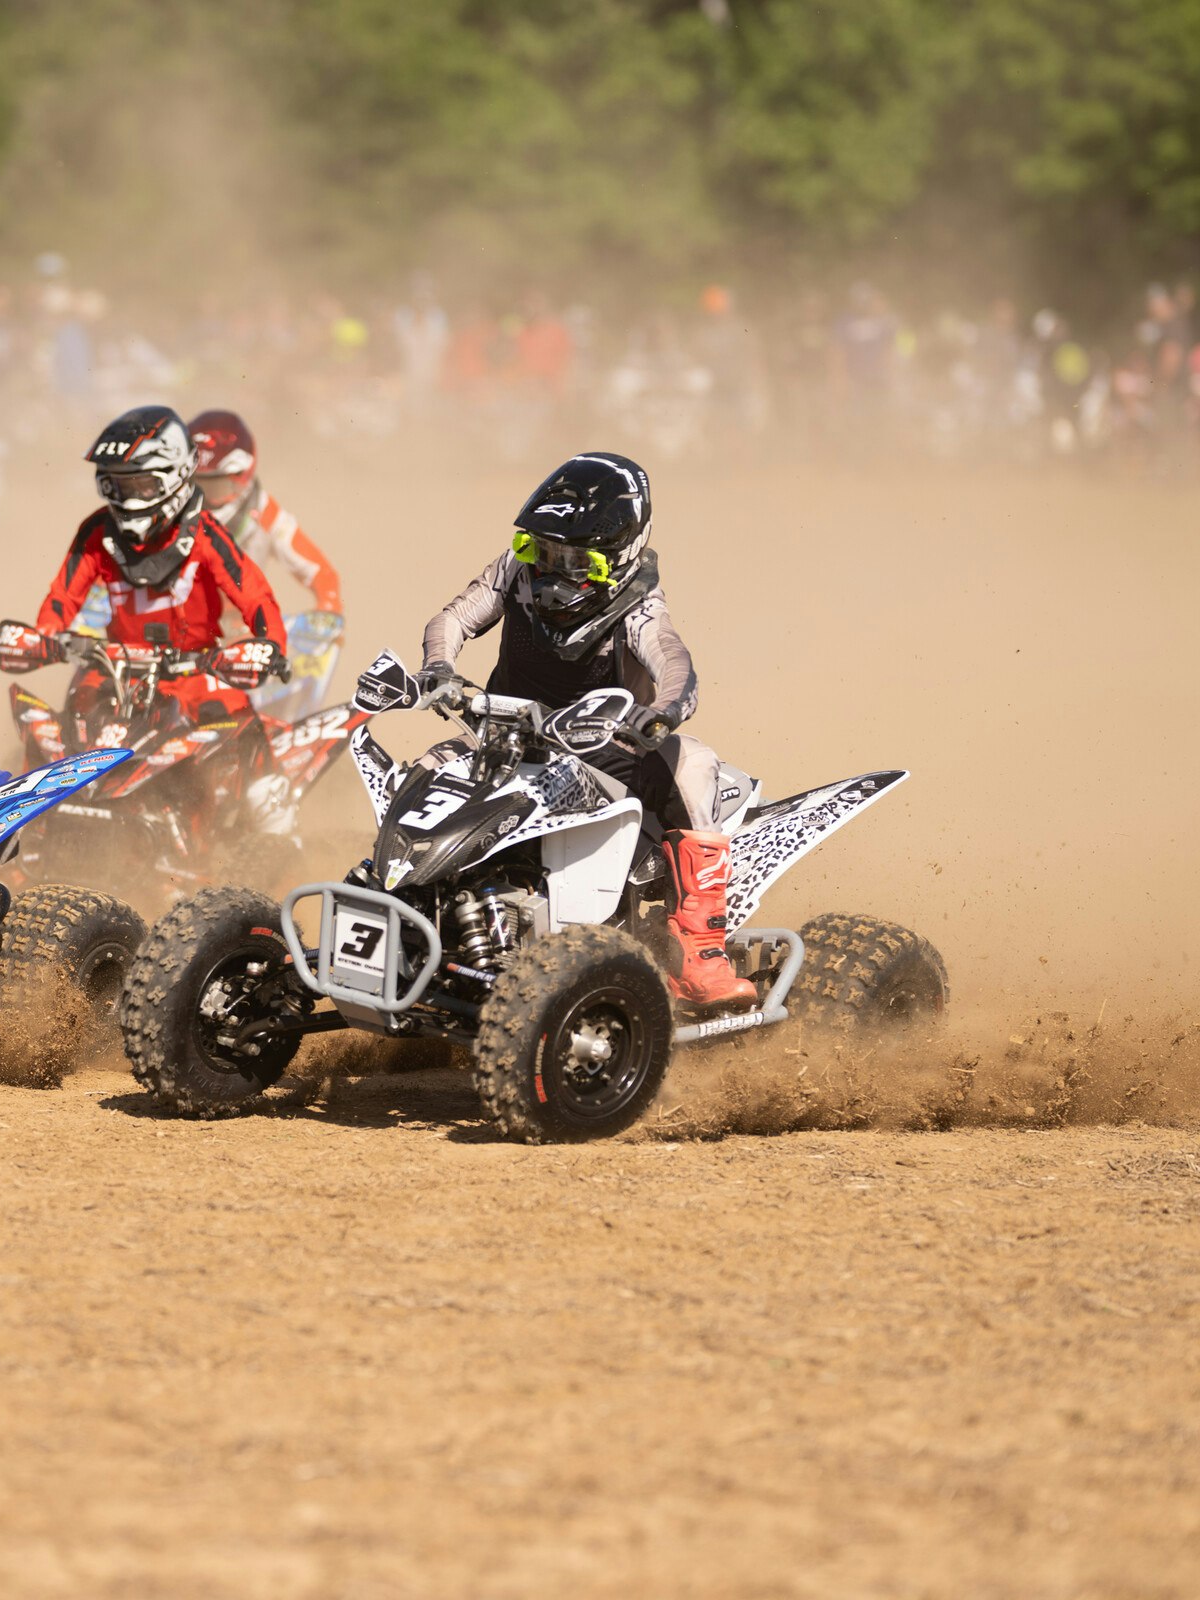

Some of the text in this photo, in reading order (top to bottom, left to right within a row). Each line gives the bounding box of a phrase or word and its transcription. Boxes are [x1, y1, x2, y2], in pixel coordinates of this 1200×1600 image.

[95, 442, 130, 456] FLY
[242, 642, 274, 665] 362
[576, 698, 608, 718] 3
[79, 755, 115, 766] KENDA
[398, 790, 467, 830] 3
[340, 922, 384, 960] 3
